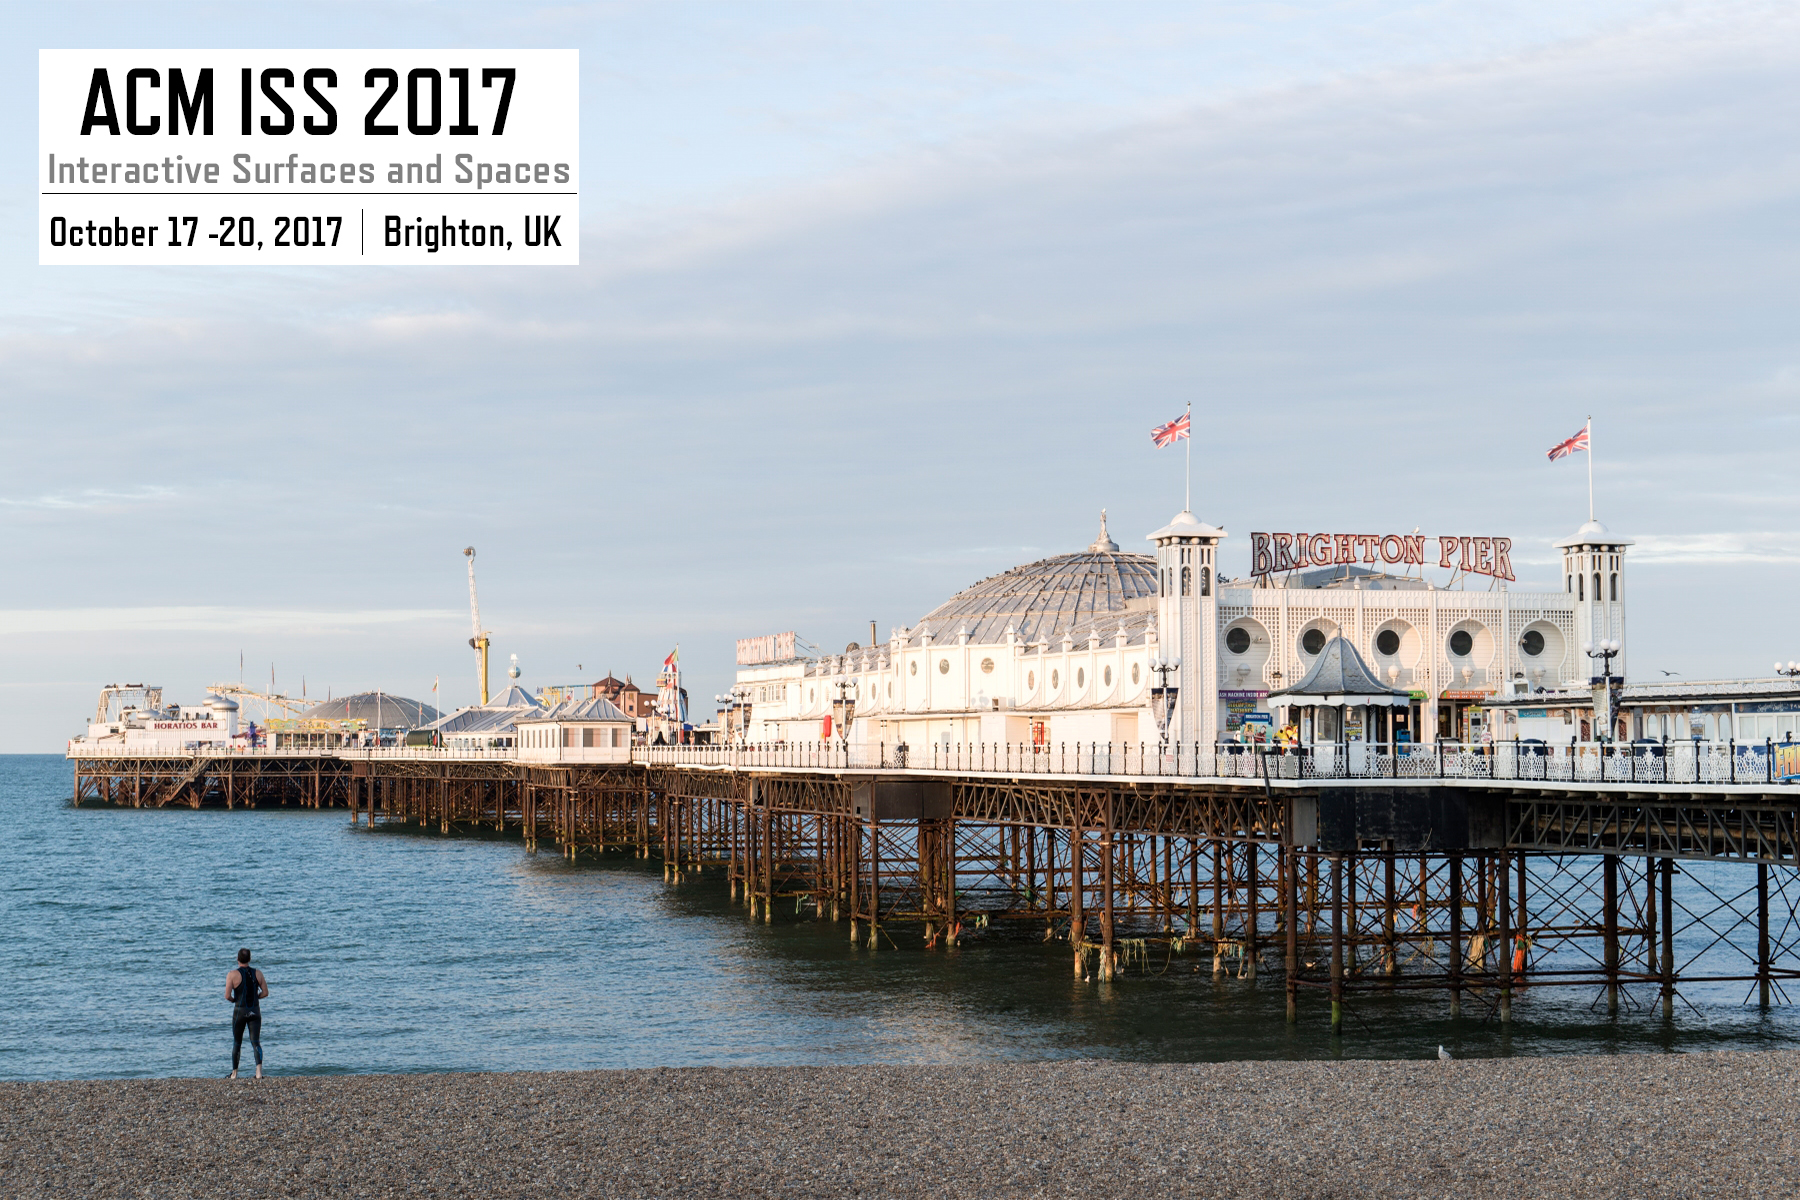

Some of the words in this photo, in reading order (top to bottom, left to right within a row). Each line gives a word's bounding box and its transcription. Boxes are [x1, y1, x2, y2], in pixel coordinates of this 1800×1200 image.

[1251, 532, 1425, 577] BRIGHTON
[1438, 536, 1516, 582] PIER
[1775, 746, 1800, 778] FA
